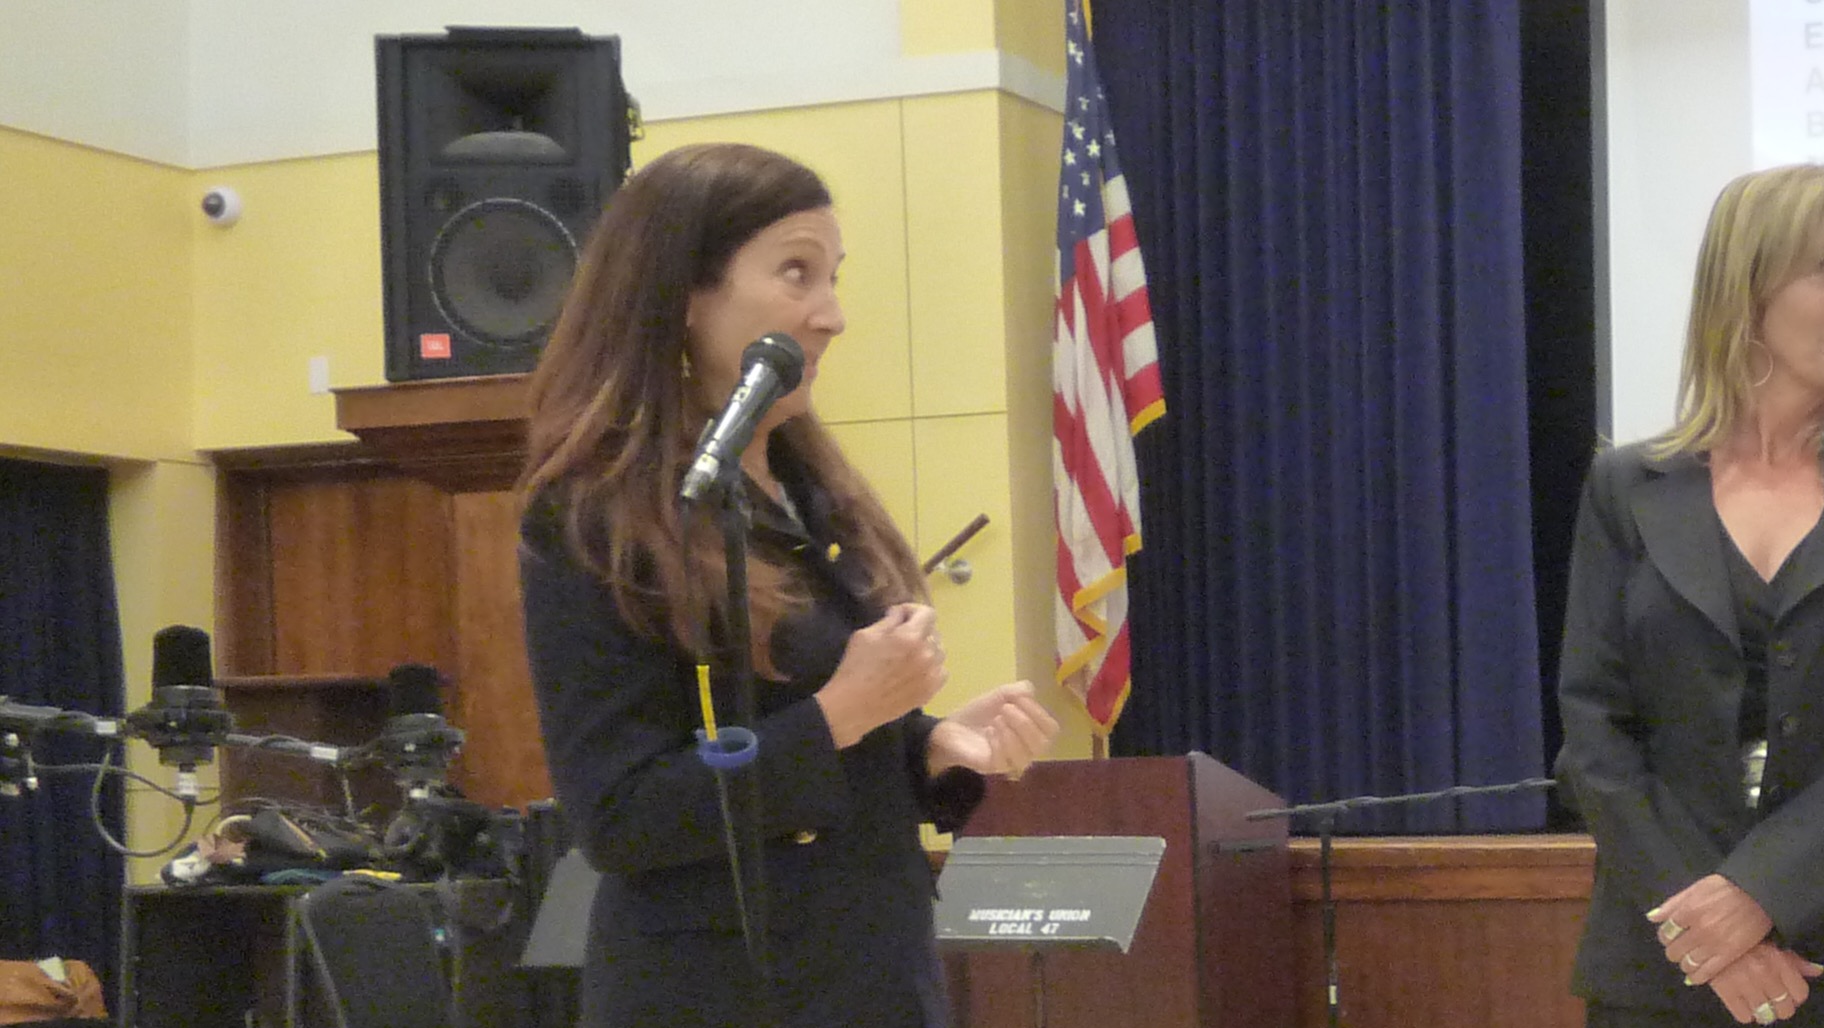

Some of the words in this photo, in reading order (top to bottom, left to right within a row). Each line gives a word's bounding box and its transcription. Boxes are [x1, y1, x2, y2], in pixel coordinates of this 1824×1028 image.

[1049, 909, 1091, 921] UNION
[988, 922, 1032, 934] LOCAL
[1040, 922, 1060, 934] 47
